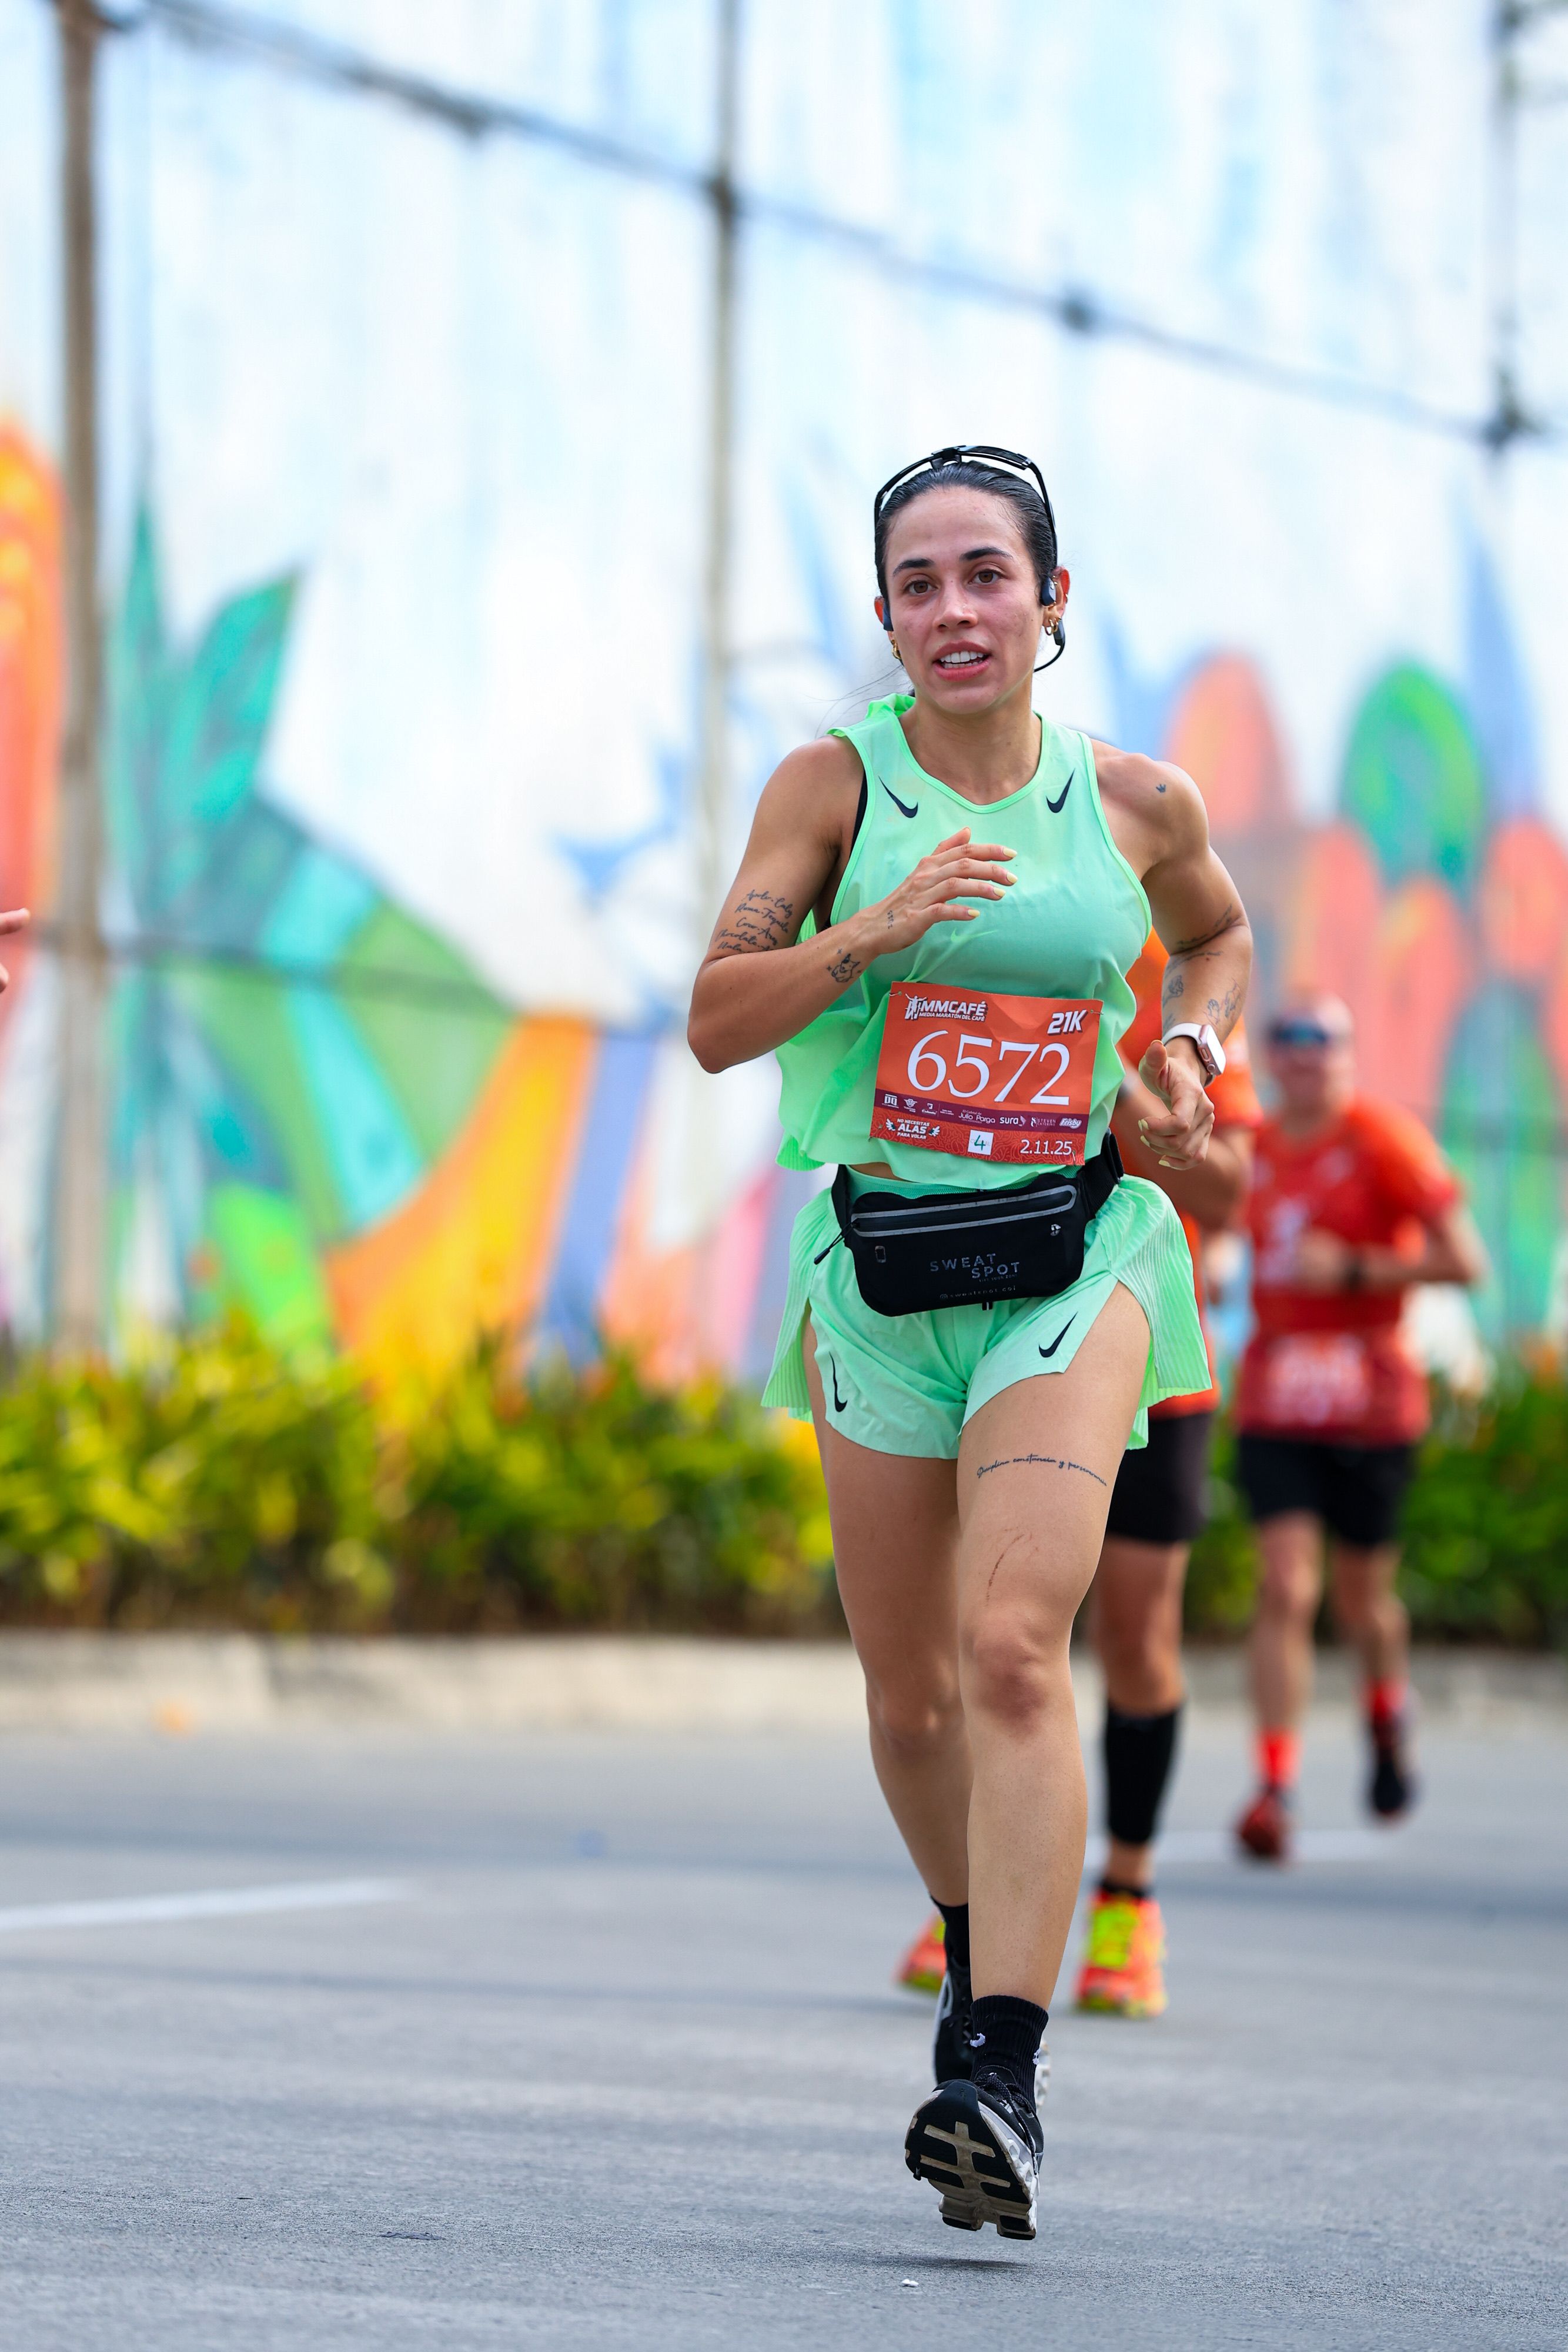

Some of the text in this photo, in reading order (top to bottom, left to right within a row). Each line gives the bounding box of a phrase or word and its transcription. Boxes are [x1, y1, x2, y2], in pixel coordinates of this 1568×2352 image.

[1047, 1010, 1087, 1035] 21K
[907, 1030, 1070, 1106] 6572
[958, 1112, 974, 1120] Julio
[976, 1115, 996, 1124] Parga
[999, 1117, 1019, 1125] sura
[1059, 1118, 1082, 1129] Frisby
[898, 1123, 927, 1134] ALAS
[974, 1134, 986, 1151] 4
[1020, 1139, 1073, 1155] 2.11.25
[930, 1253, 996, 1272] SWEAT
[971, 1262, 1020, 1279] SPOT
[1058, 1461, 1065, 1469] y
